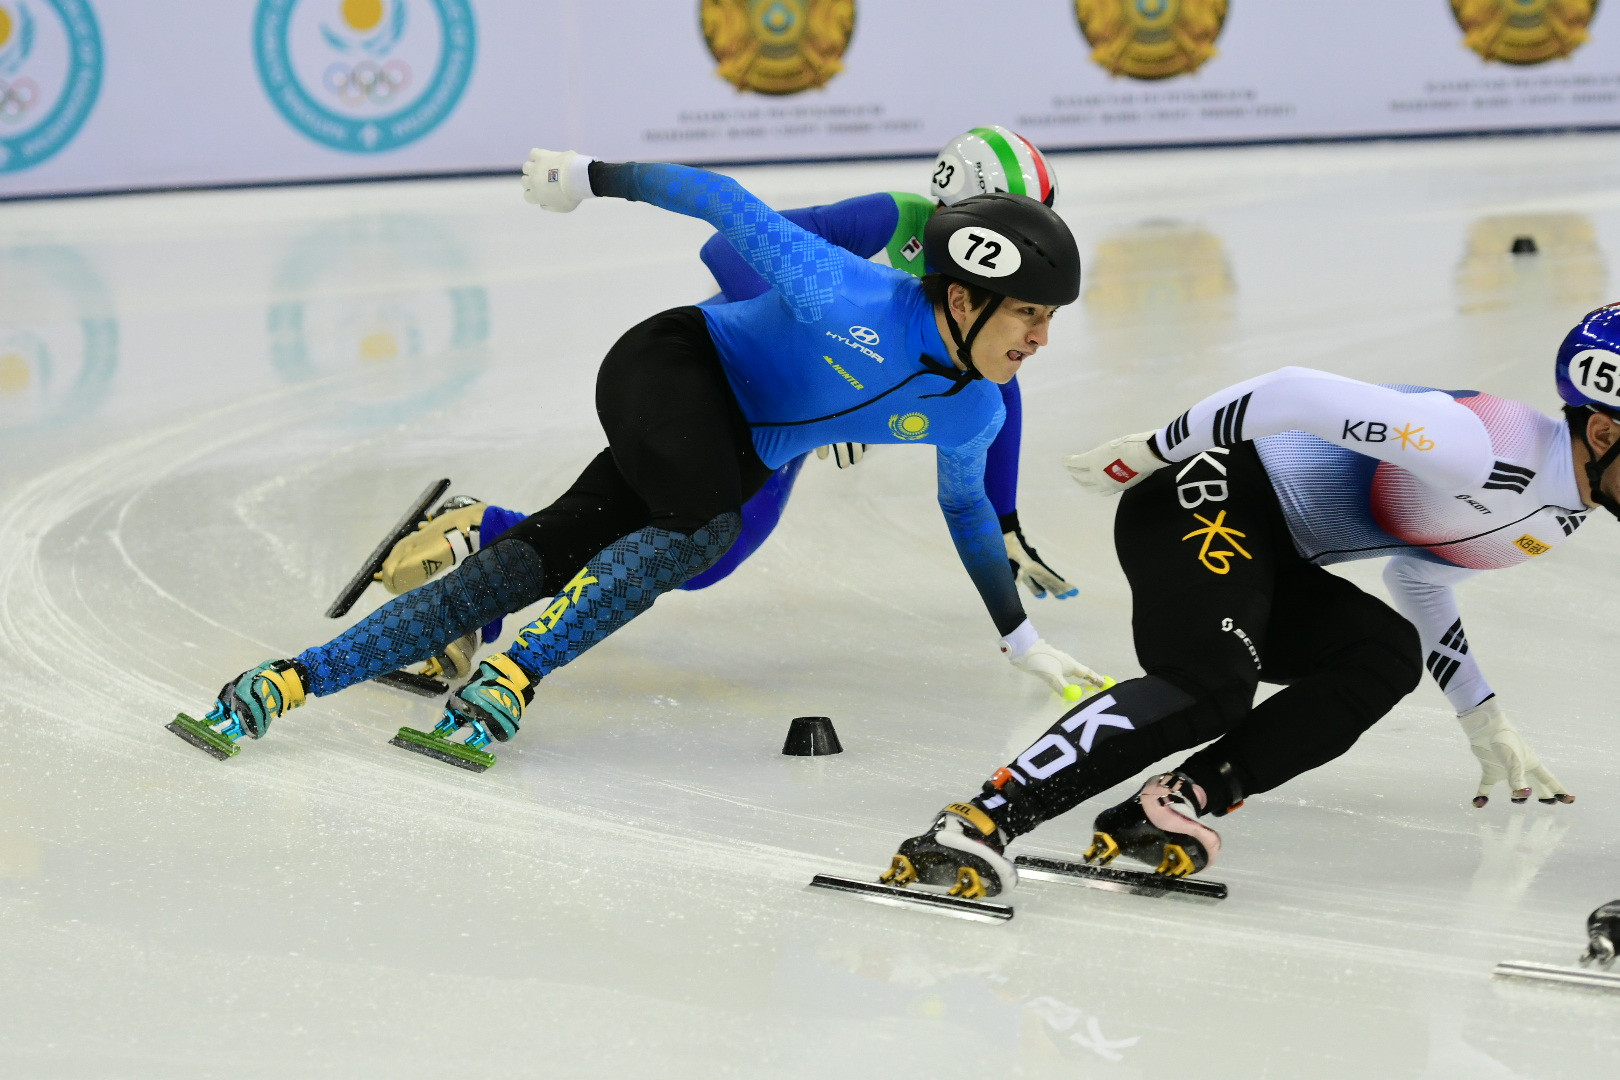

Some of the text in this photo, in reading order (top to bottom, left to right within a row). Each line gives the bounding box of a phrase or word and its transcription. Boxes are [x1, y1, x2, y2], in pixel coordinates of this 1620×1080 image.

[932, 160, 955, 189] 23
[964, 233, 1002, 270] 72
[826, 331, 885, 364] HYUNDAI
[832, 364, 865, 391] HUNTER
[1342, 419, 1387, 443] KB
[1175, 446, 1230, 510] KB
[1465, 499, 1492, 515] SCOTT
